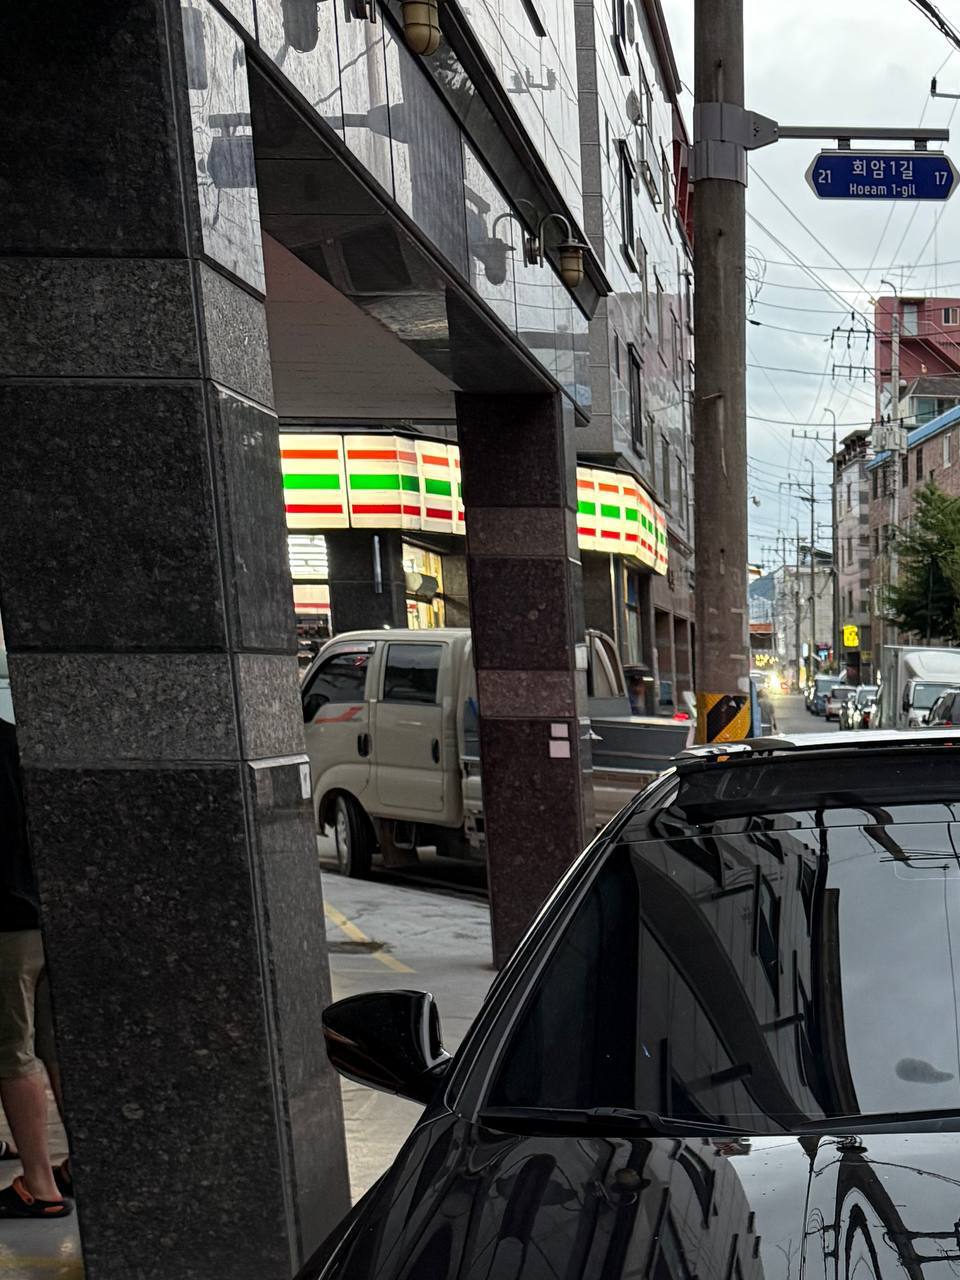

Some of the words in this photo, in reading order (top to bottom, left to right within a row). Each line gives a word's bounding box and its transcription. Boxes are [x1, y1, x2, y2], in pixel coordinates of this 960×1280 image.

[818, 169, 832, 184] 21
[852, 159, 914, 181] 회암1길
[934, 171, 948, 186] 17
[849, 183, 887, 196] Hoeam
[891, 183, 916, 198] 1-gil
